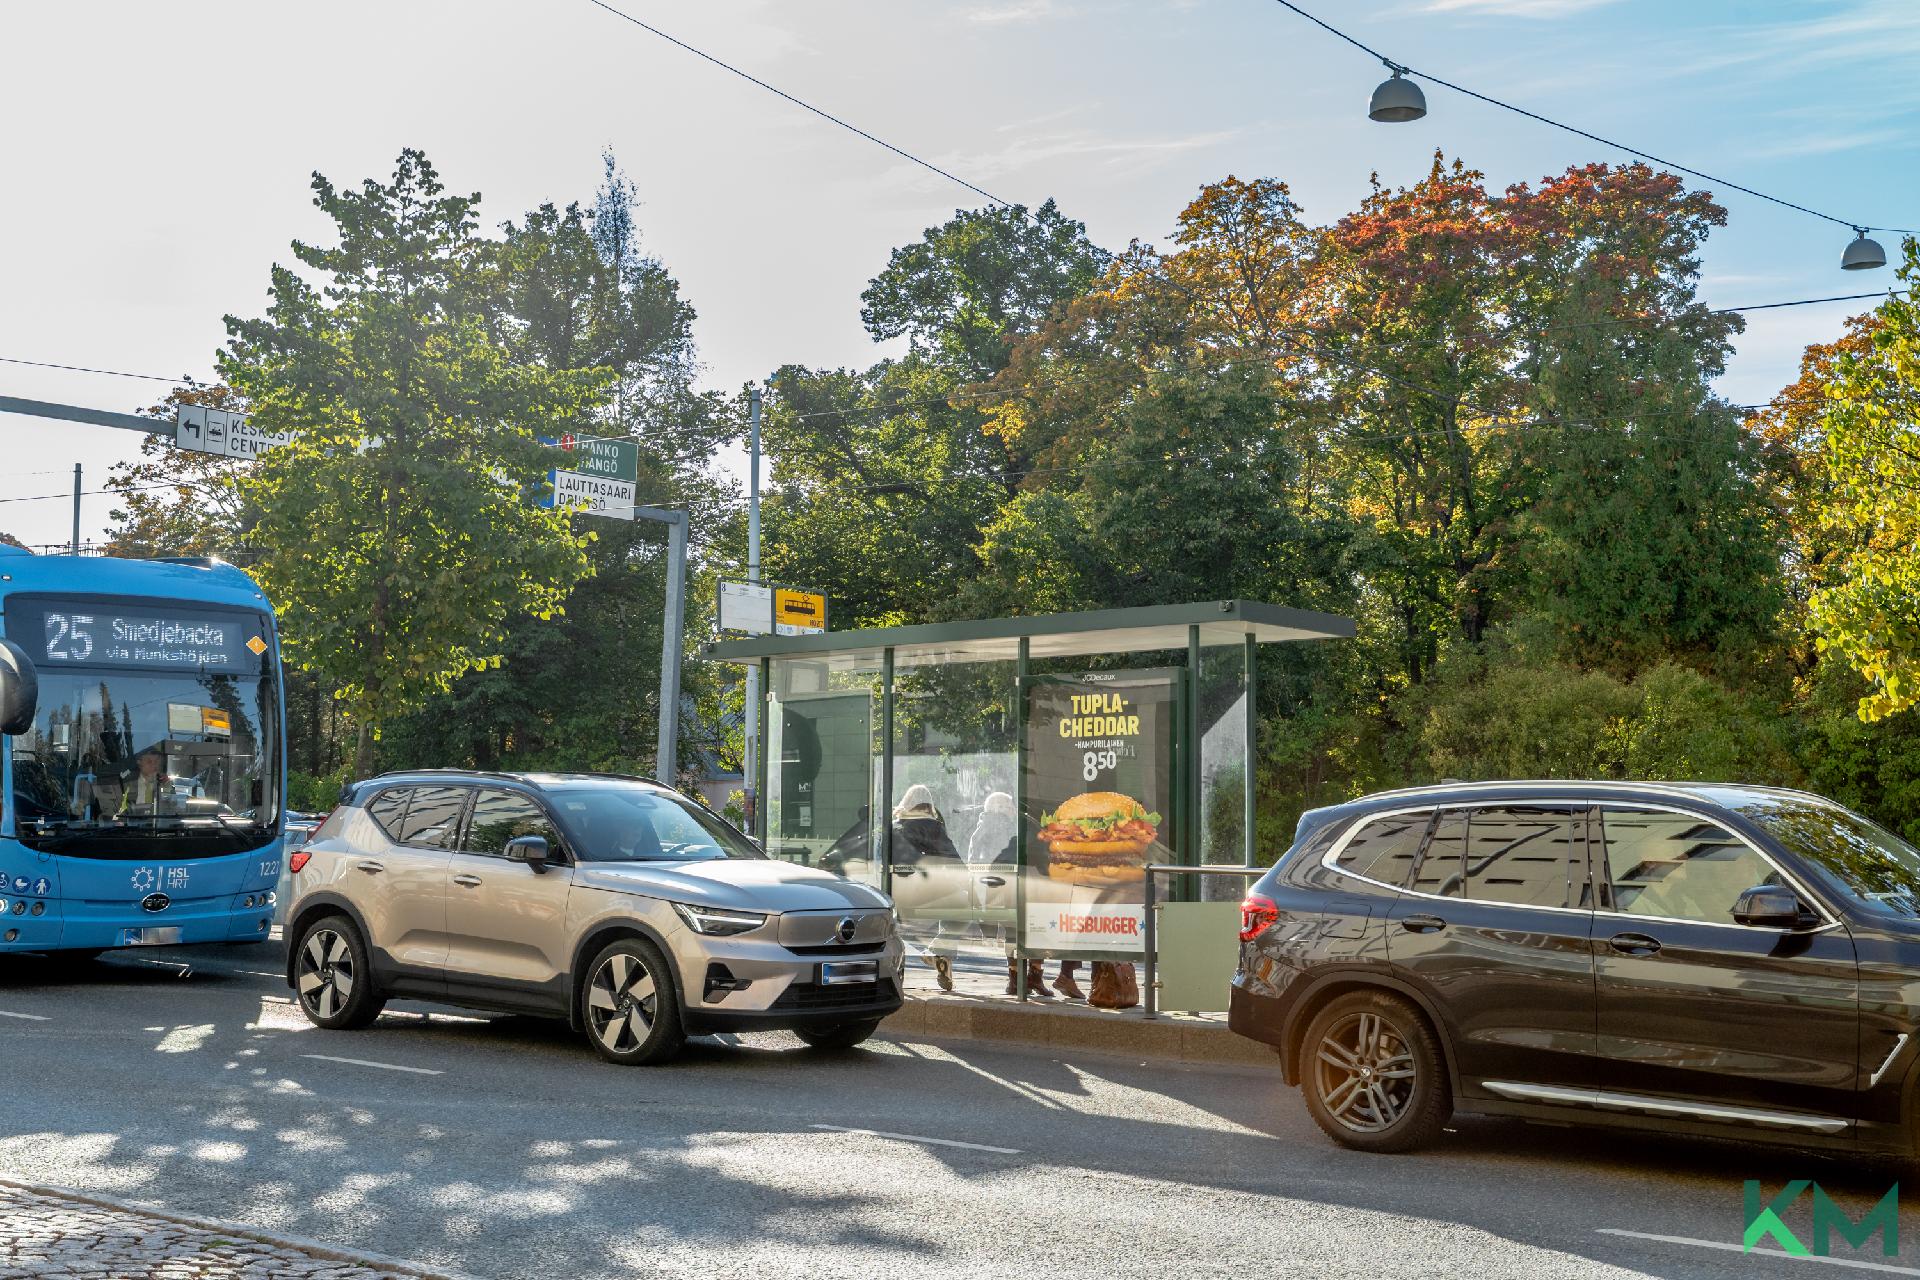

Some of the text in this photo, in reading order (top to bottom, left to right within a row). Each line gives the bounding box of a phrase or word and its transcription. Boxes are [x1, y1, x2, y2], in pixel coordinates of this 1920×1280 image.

[580, 456, 618, 473] ANGÖ
[559, 477, 631, 500] LAUTTASAARI
[46, 613, 94, 660] 25
[112, 618, 223, 647] Smedjebacka
[105, 645, 129, 659] via
[1070, 693, 1129, 715] TUPLA-
[1059, 715, 1140, 738] CHEDDAR
[166, 878, 190, 889] HRT
[167, 867, 190, 878] HSL
[1059, 911, 1138, 937] HESBURGER
